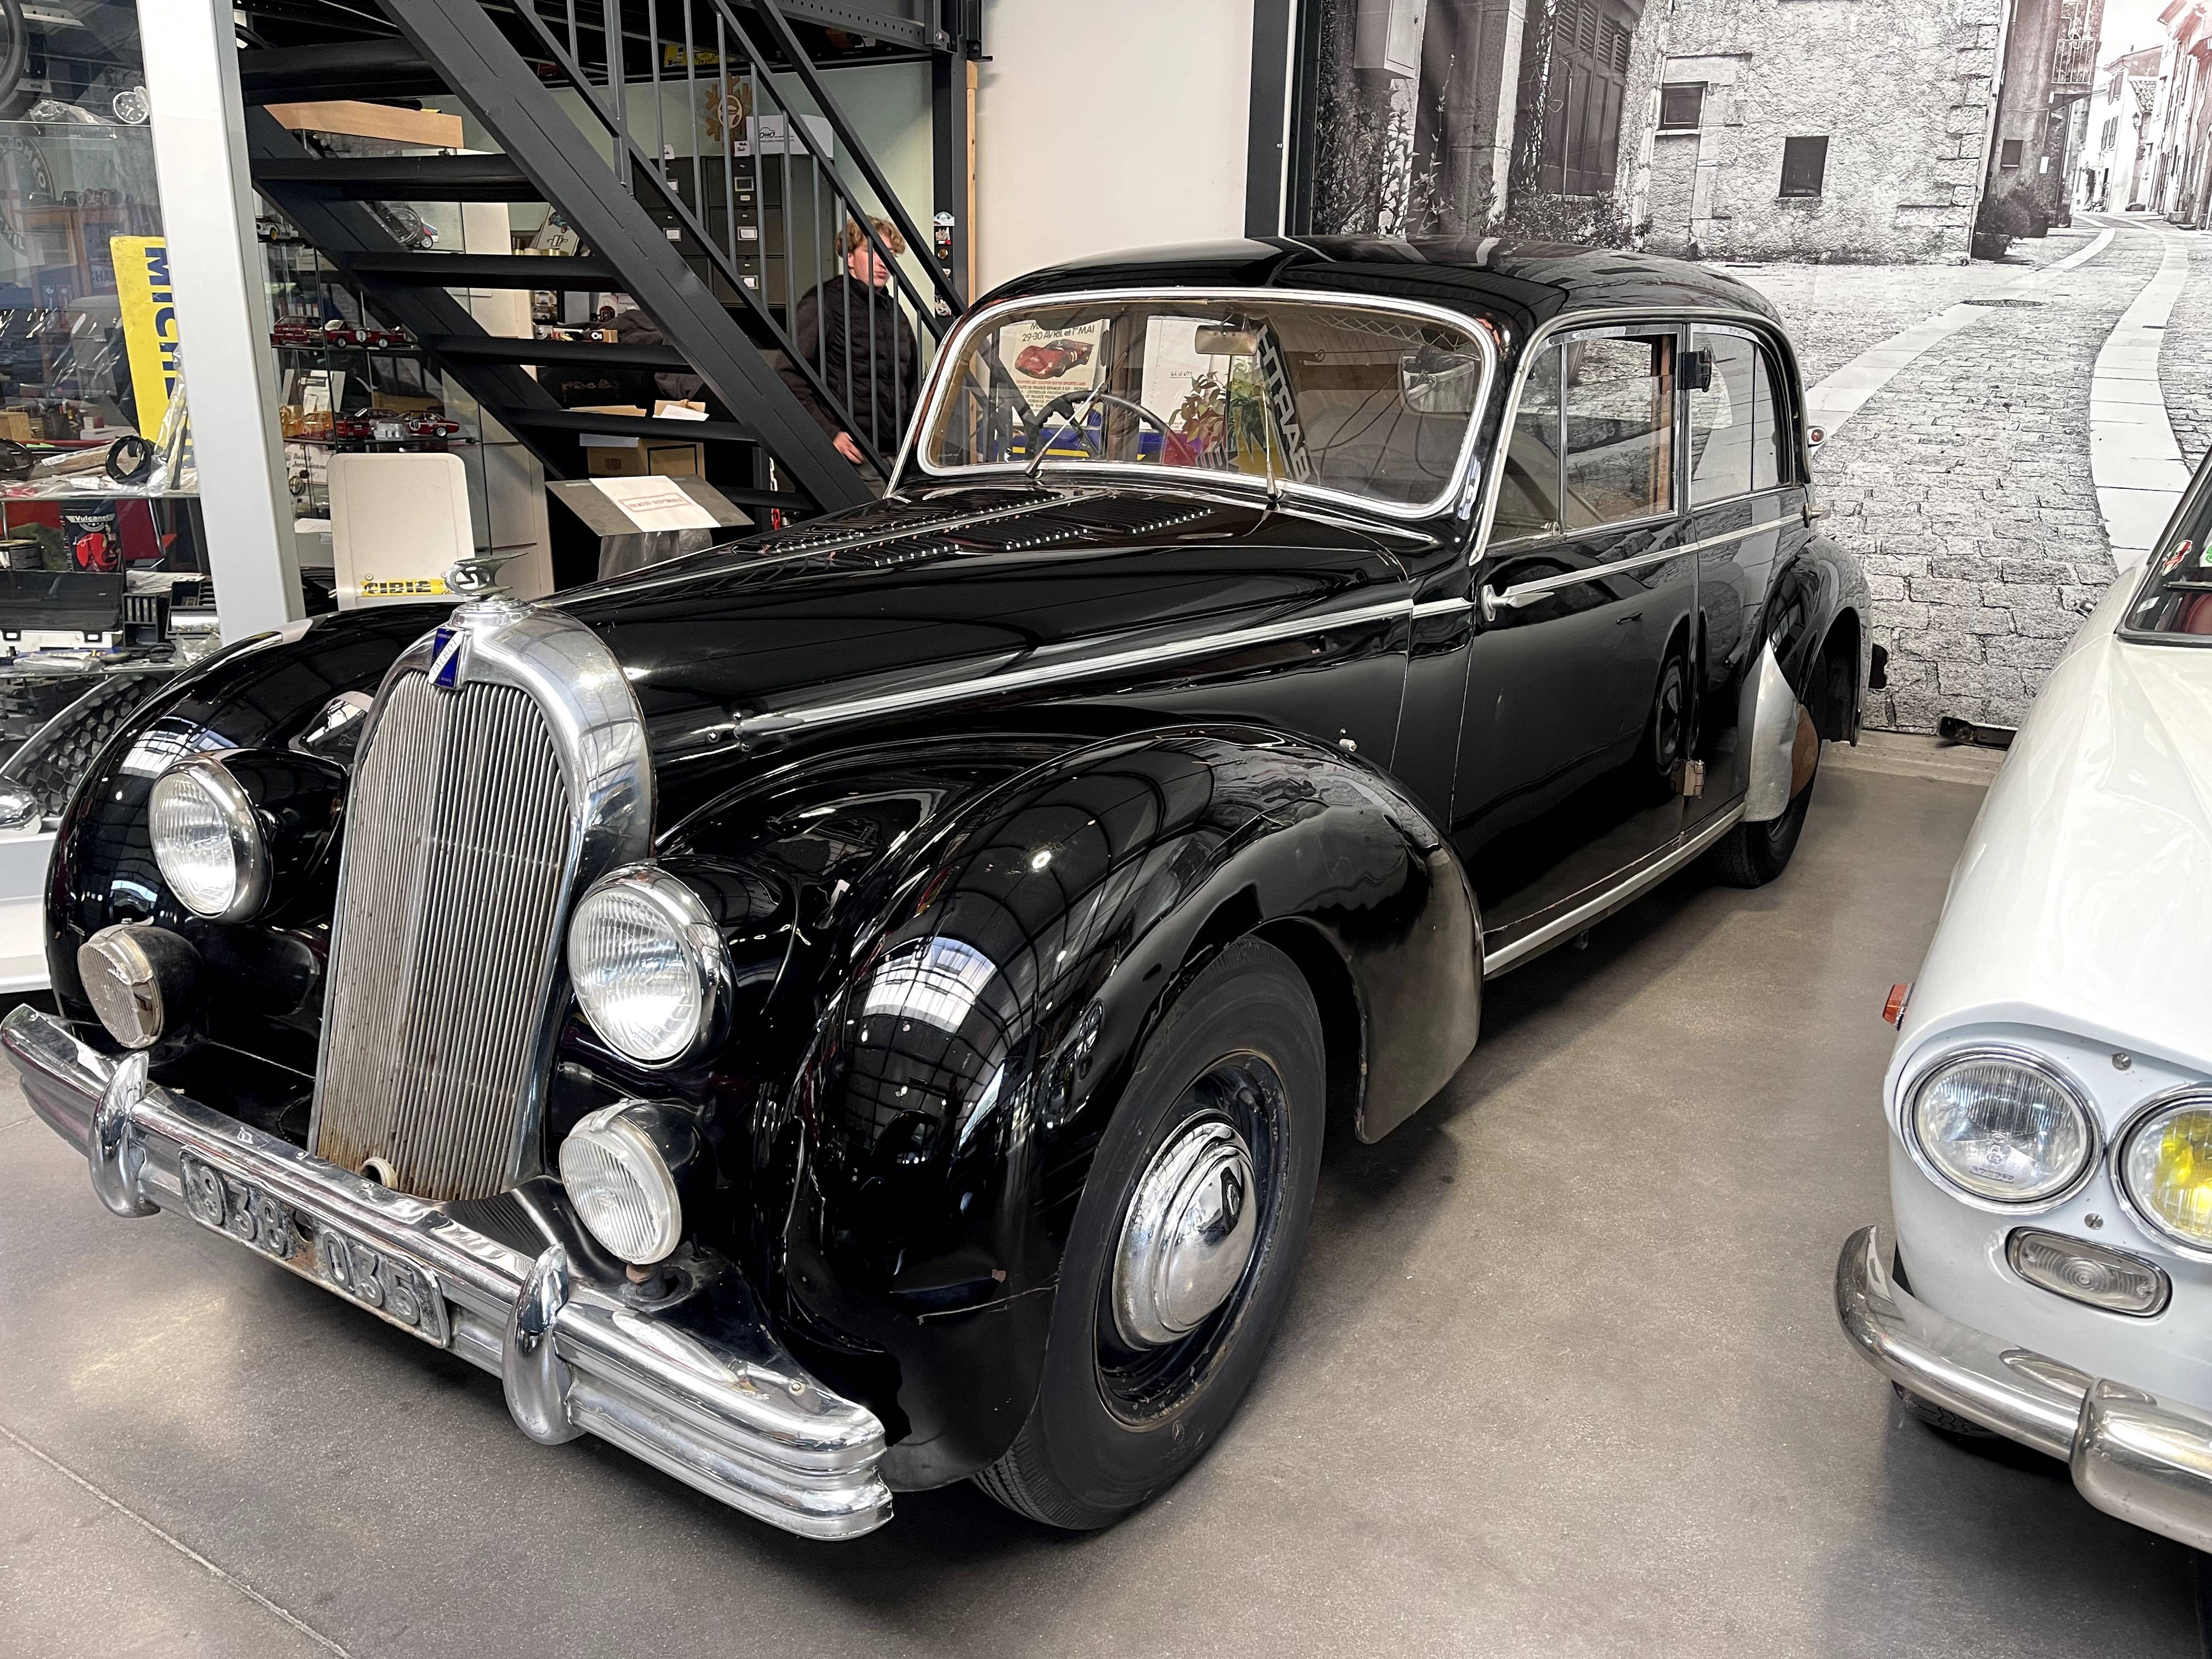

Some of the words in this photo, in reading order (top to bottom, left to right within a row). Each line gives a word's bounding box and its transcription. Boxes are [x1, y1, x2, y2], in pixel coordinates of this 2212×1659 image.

[145, 247, 178, 399] MICH
[1022, 331, 1043, 342] 29-30
[1043, 330, 1063, 339] AVRIL
[1078, 325, 1095, 335] MAI
[411, 421, 419, 430] 40
[431, 639, 458, 675] TALBOT
[199, 1166, 284, 1255] 938
